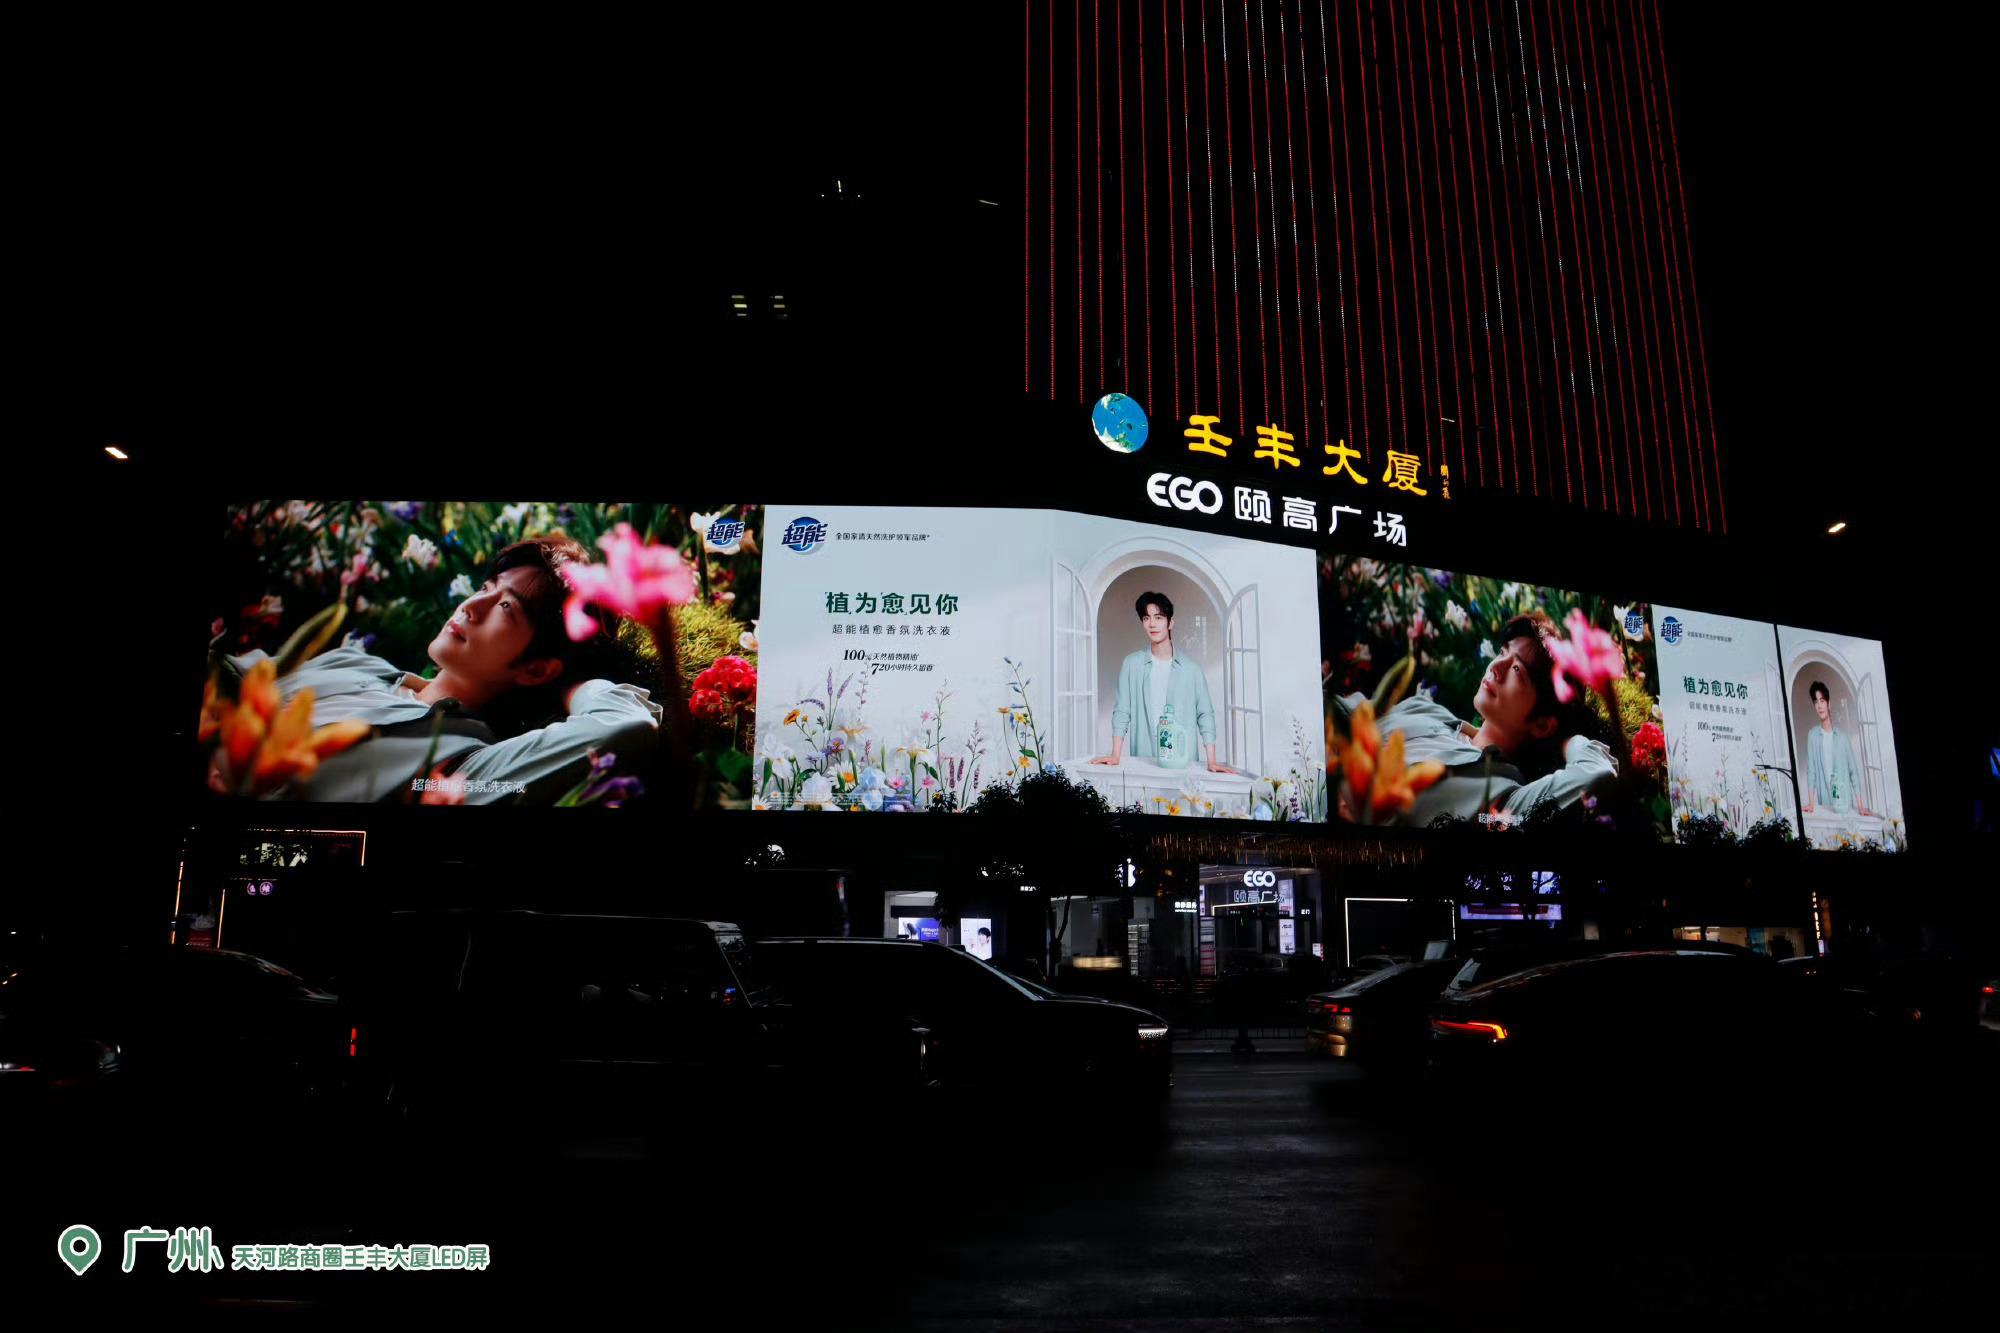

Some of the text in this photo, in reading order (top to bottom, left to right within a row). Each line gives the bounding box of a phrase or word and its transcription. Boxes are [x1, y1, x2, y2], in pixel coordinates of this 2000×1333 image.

[1183, 413, 1427, 497] 壬丰大厦
[1146, 472, 1407, 547] EGO 颐高广场
[706, 521, 746, 542] 超能
[781, 522, 828, 546] 超能
[831, 624, 951, 636] 超能植愈香氛洗衣液
[1624, 615, 1643, 632] 超能
[1661, 623, 1683, 639] 超能
[1243, 870, 1276, 888] EGO
[1233, 890, 1286, 903] 颐高广场
